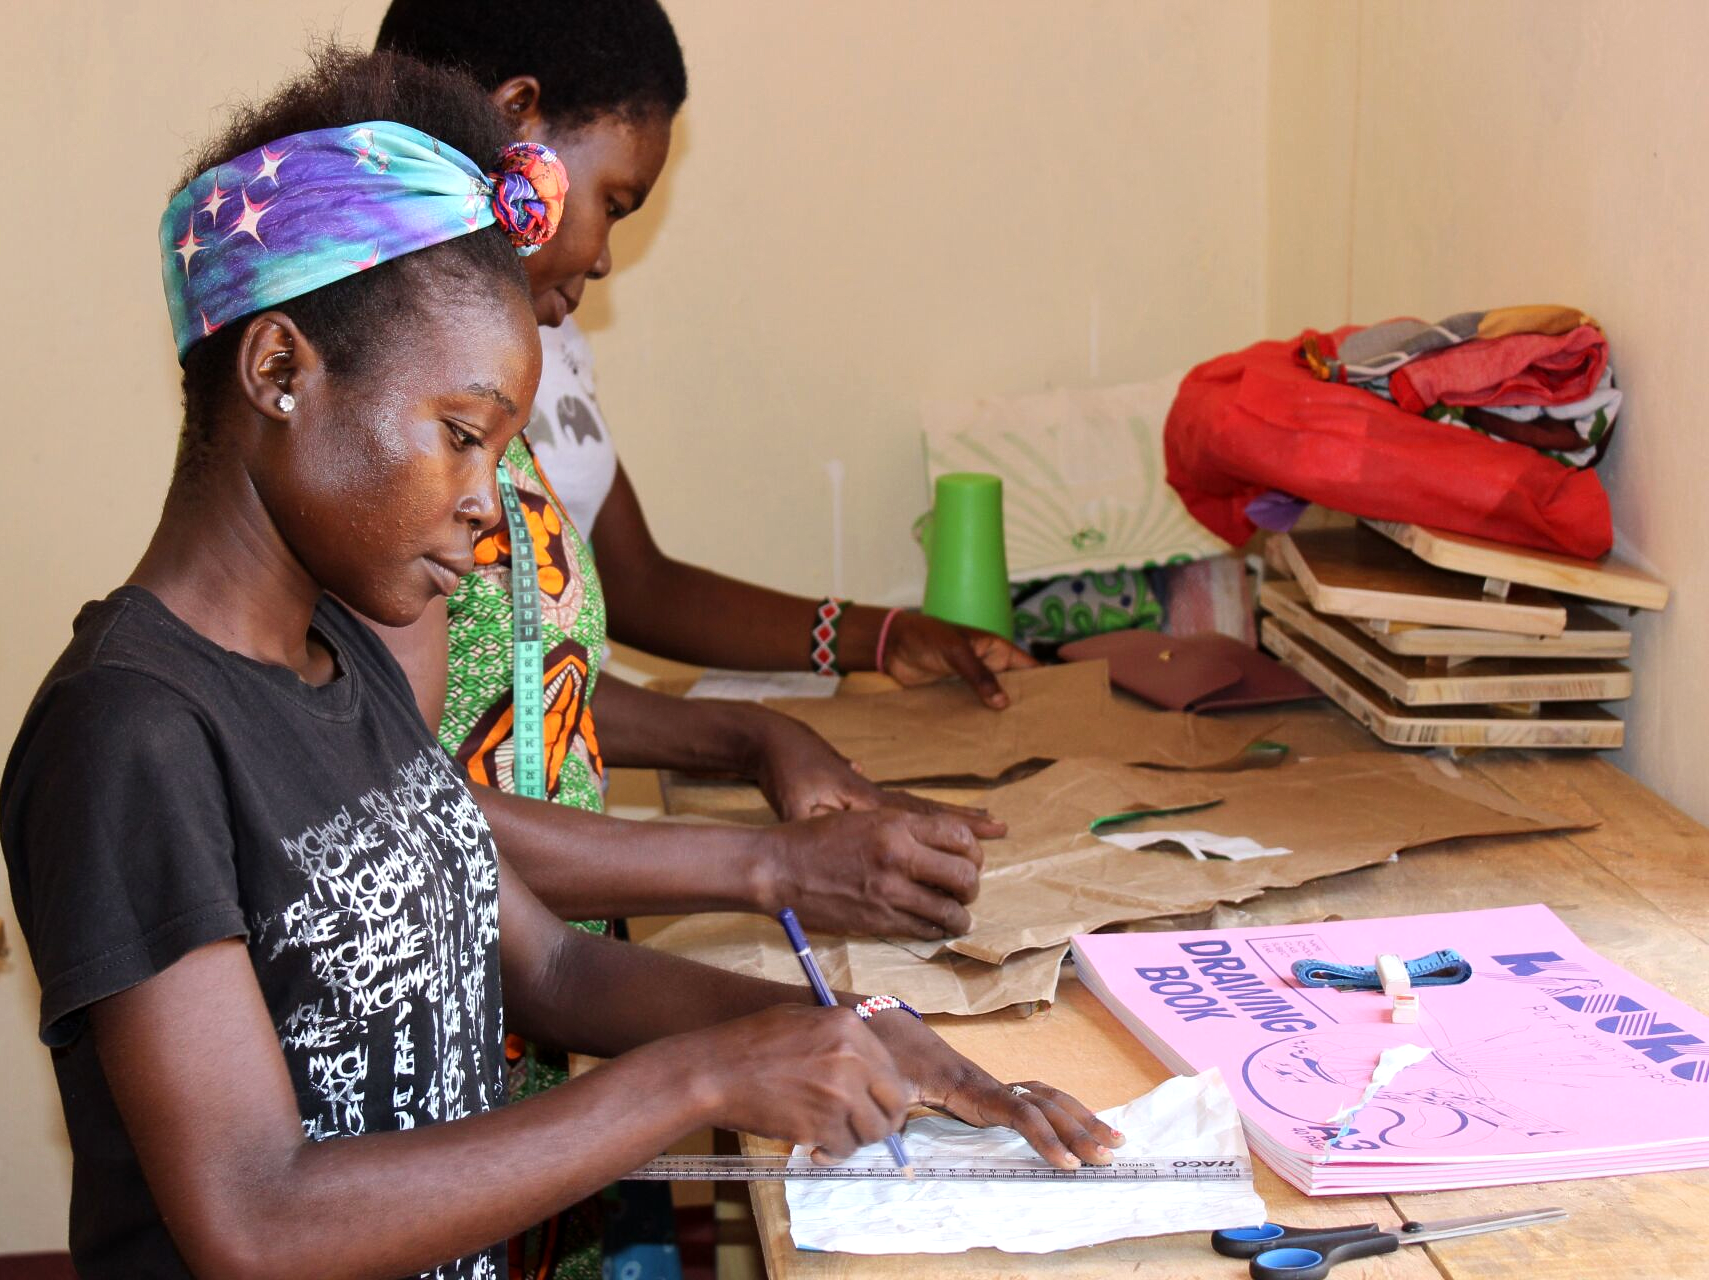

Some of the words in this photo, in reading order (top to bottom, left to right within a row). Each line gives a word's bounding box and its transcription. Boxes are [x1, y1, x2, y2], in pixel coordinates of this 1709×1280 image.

[1135, 966, 1237, 1022] BOOK
[1179, 940, 1317, 1032] DRAWING
[1307, 1126, 1381, 1150] A3
[1172, 1160, 1235, 1168] HACO
